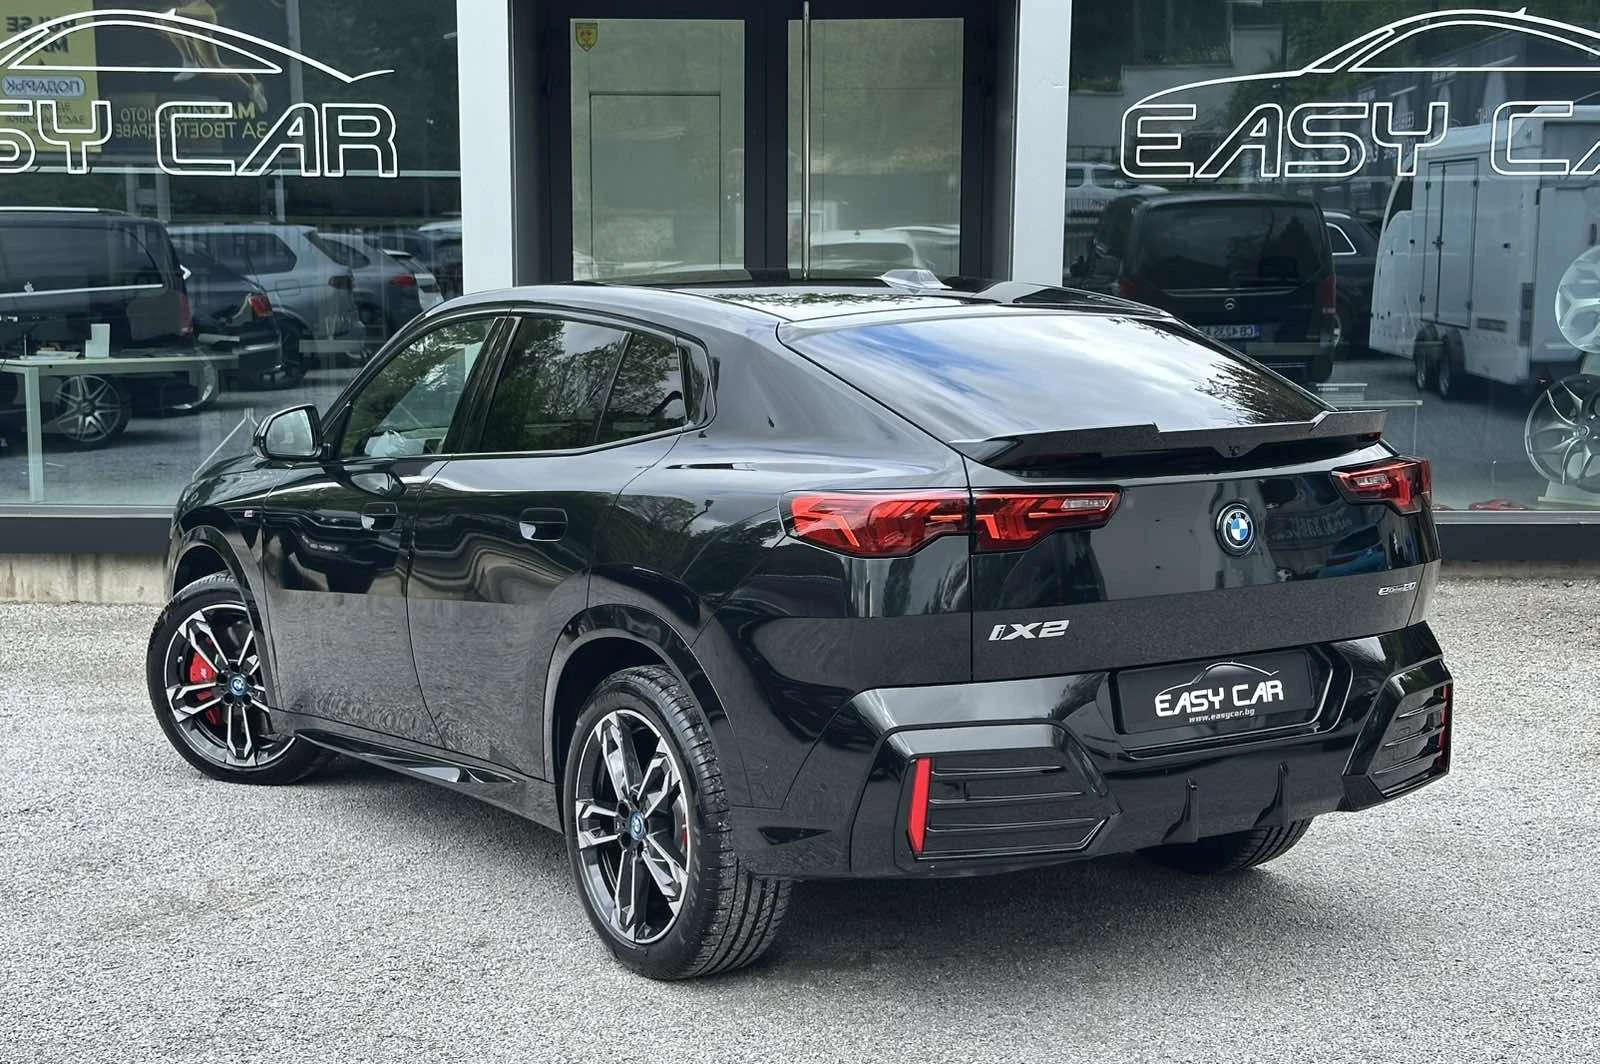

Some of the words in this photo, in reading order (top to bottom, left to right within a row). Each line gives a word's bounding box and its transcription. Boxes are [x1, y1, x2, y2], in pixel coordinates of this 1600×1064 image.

[156, 101, 398, 178] CAR
[1120, 102, 1448, 178] EASY
[988, 619, 1070, 641] iX2
[1154, 687, 1225, 717] EASY
[1231, 679, 1284, 707] CAR
[1188, 707, 1256, 723] www.easycar.bg
